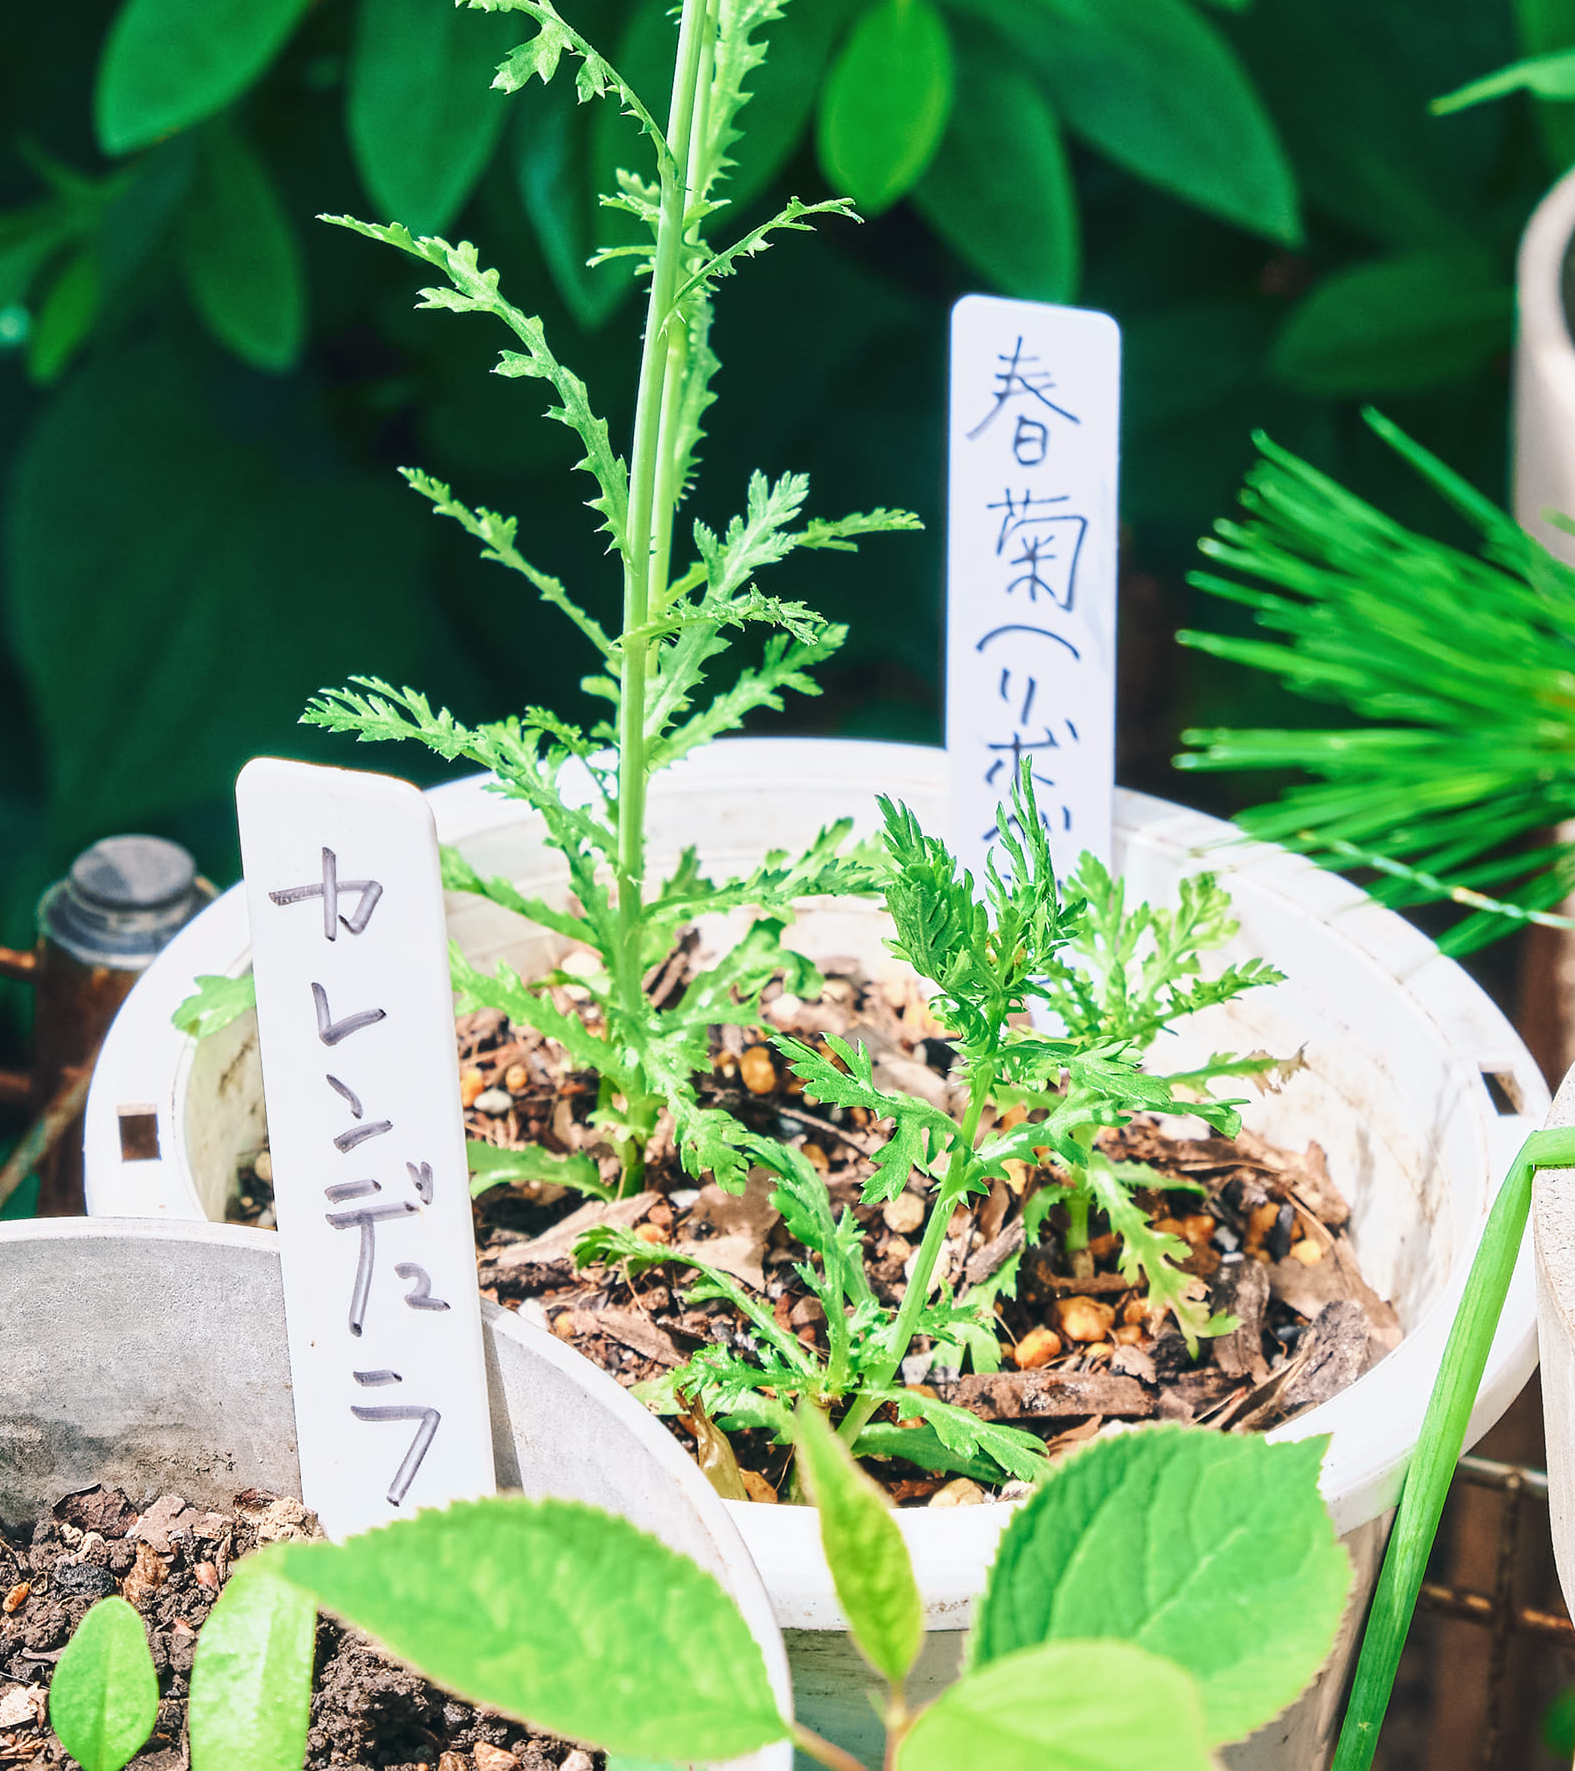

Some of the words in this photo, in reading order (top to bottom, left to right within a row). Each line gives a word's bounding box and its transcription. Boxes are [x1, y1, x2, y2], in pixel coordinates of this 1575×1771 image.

[267, 844, 453, 1509] カレンデュラ
